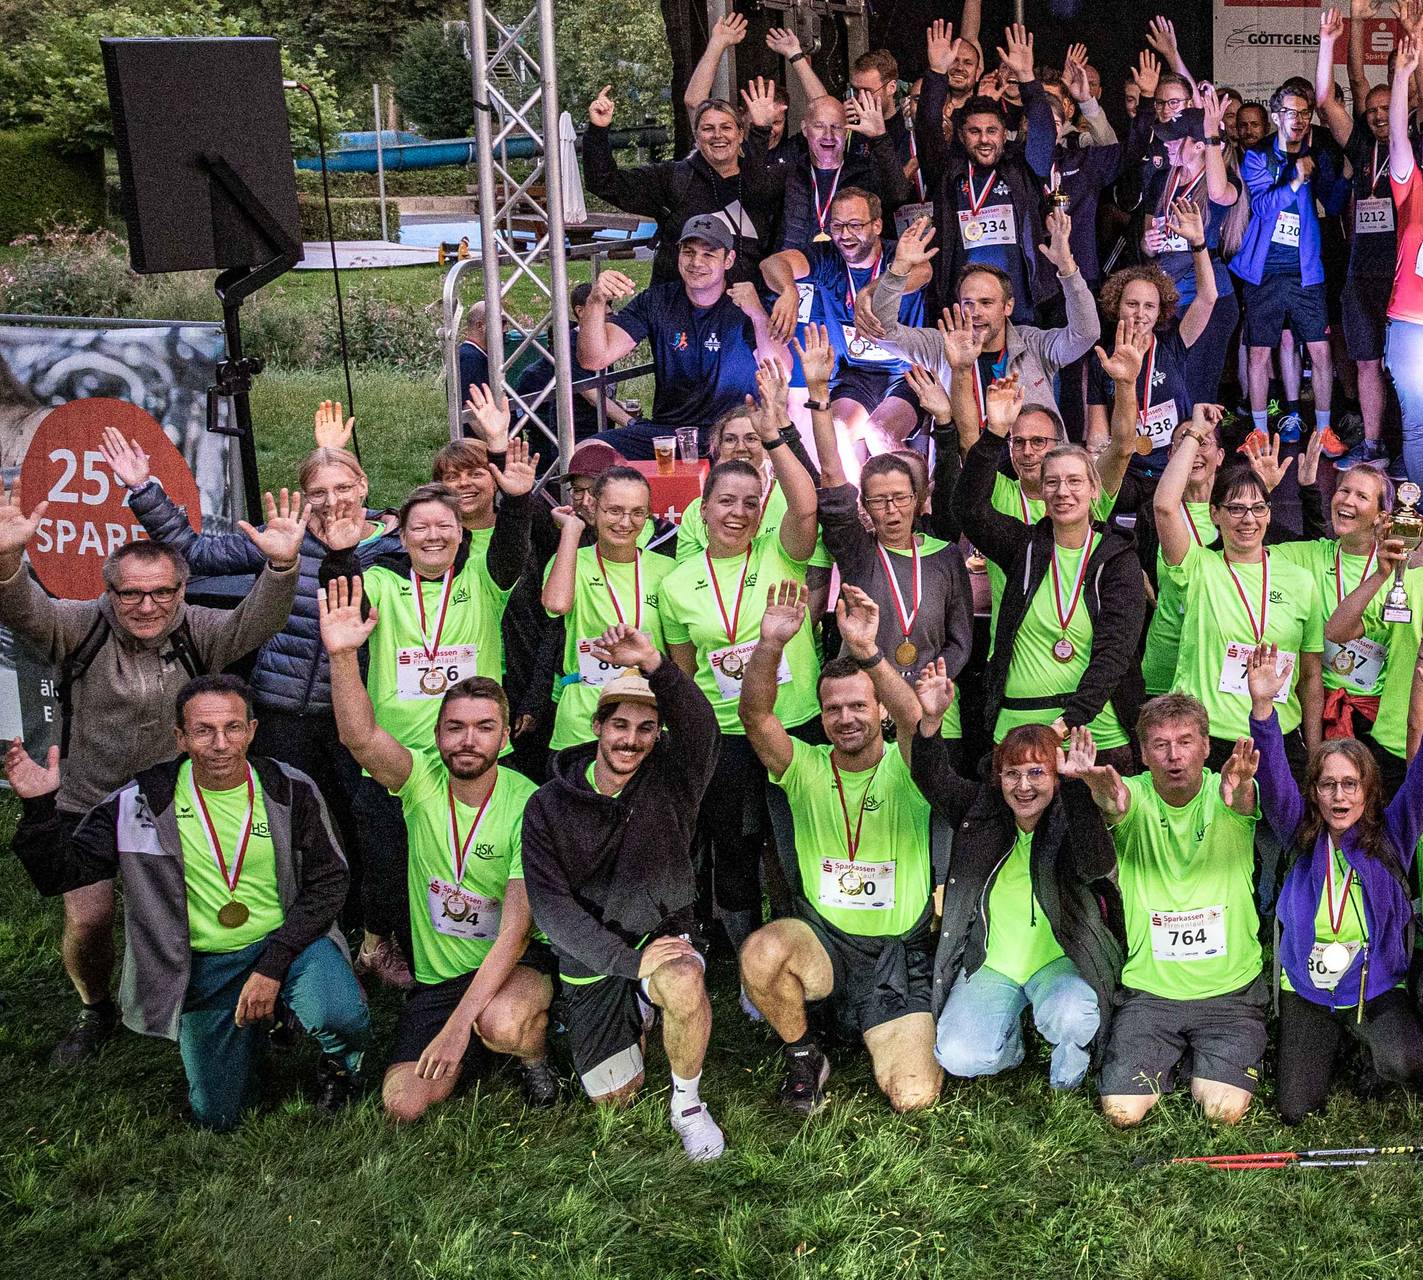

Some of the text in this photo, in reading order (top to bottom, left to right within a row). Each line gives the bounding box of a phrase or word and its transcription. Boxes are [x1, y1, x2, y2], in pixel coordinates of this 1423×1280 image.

[1248, 31, 1320, 45] GÖTTGENS
[1359, 211, 1386, 223] 1212
[980, 219, 1007, 233] 234
[1279, 223, 1300, 237] 120
[37, 518, 150, 556] SPARE
[413, 650, 458, 660] Spaassen
[252, 823, 271, 834] HS
[475, 844, 494, 856] HSK
[835, 863, 876, 873] Sparkassen
[1163, 914, 1204, 923] Sparkassen
[1168, 928, 1207, 946] 764
